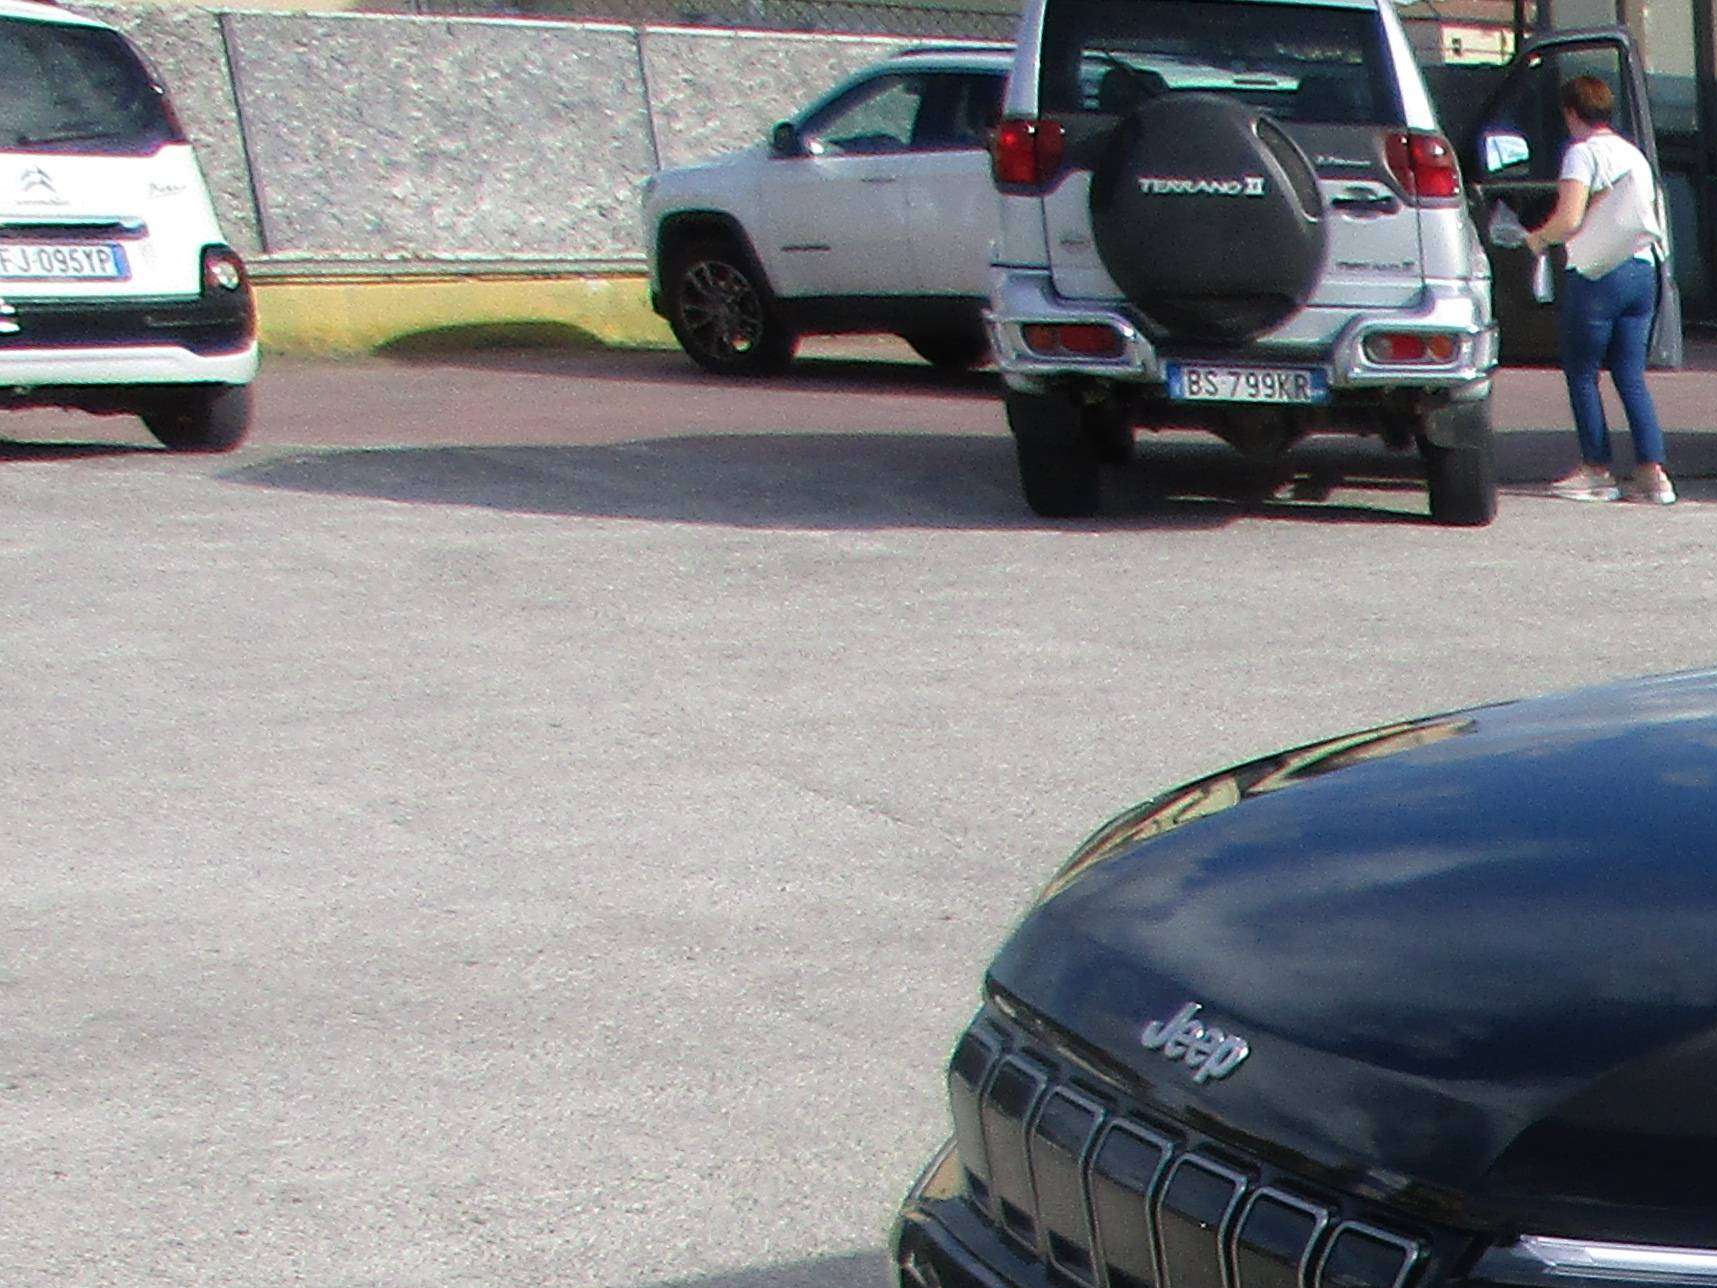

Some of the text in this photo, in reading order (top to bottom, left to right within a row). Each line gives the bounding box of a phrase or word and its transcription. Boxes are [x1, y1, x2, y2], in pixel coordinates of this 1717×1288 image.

[1138, 176, 1266, 197] TERRANO II
[34, 248, 110, 274] 095YP
[1187, 369, 1310, 400] BS 799KR
[1140, 1001, 1251, 1084] Jeep
